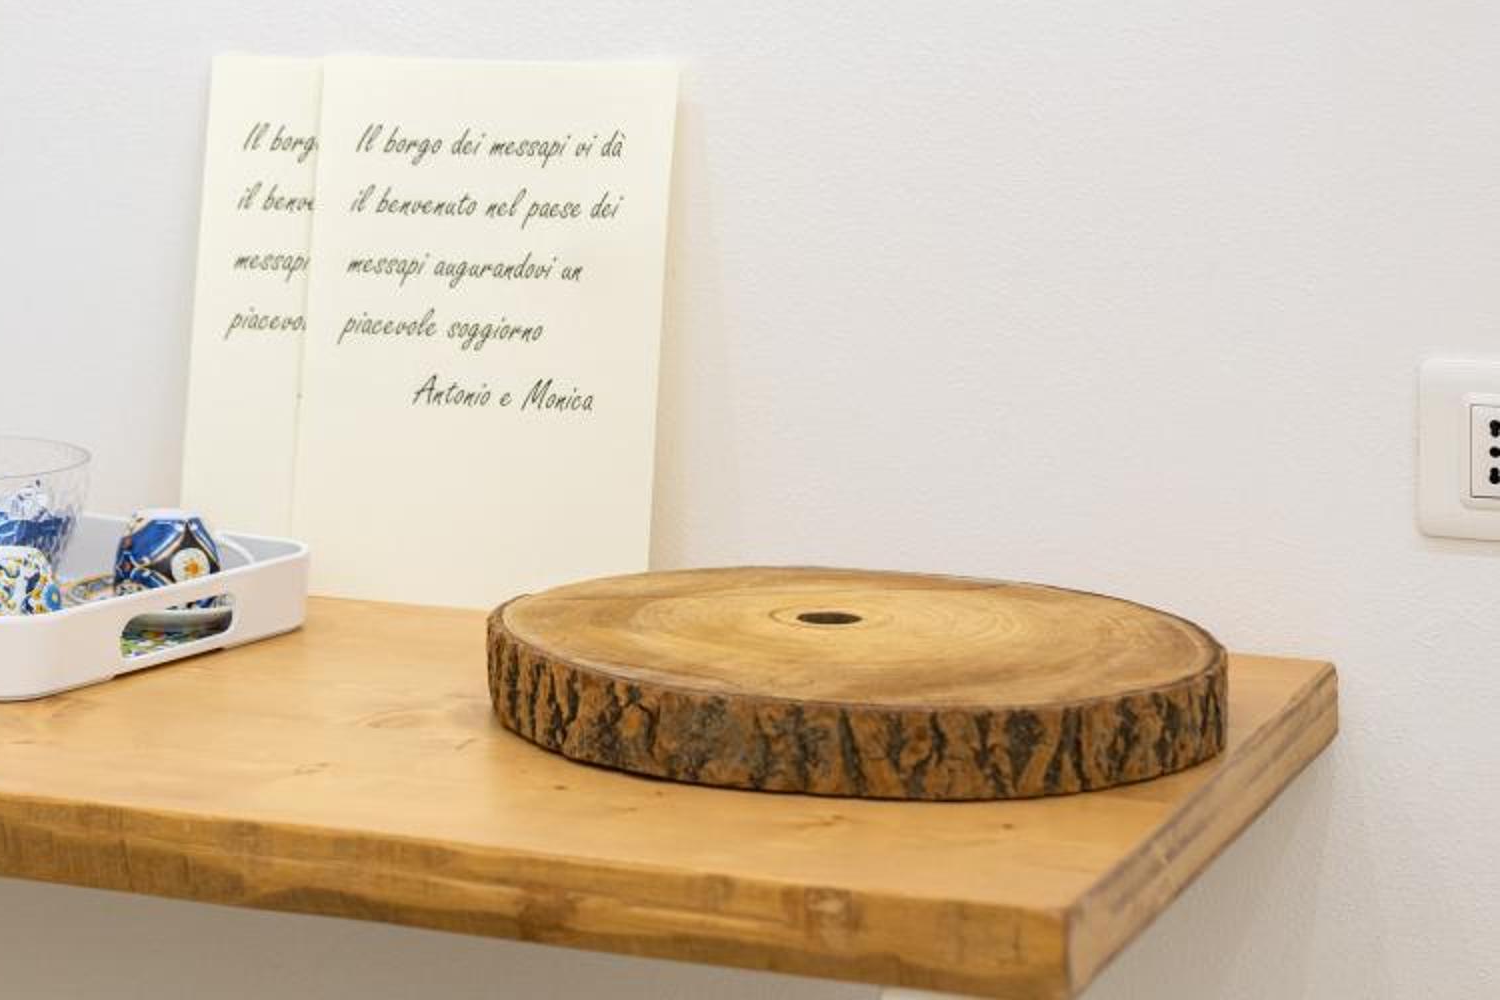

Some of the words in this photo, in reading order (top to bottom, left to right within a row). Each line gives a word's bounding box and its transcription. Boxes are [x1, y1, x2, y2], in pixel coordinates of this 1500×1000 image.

[244, 122, 270, 150] Il
[356, 124, 384, 152] Il
[384, 127, 442, 165] borgo
[452, 129, 486, 155] dei
[489, 136, 572, 168] messapi
[575, 136, 598, 157] vi
[601, 131, 626, 158] dà
[237, 182, 262, 210] il
[350, 185, 376, 212] il
[376, 188, 478, 217] benvenuto
[486, 187, 527, 218] nel
[521, 201, 581, 229] paese
[590, 191, 624, 218] dei
[346, 252, 430, 286] messapi
[434, 252, 557, 288] augurandovi
[561, 265, 583, 281] un
[337, 307, 437, 344] piacevole
[447, 318, 544, 350] soggiorno
[412, 374, 491, 406] Antonio
[500, 392, 511, 406] e
[520, 378, 594, 411] Monica
